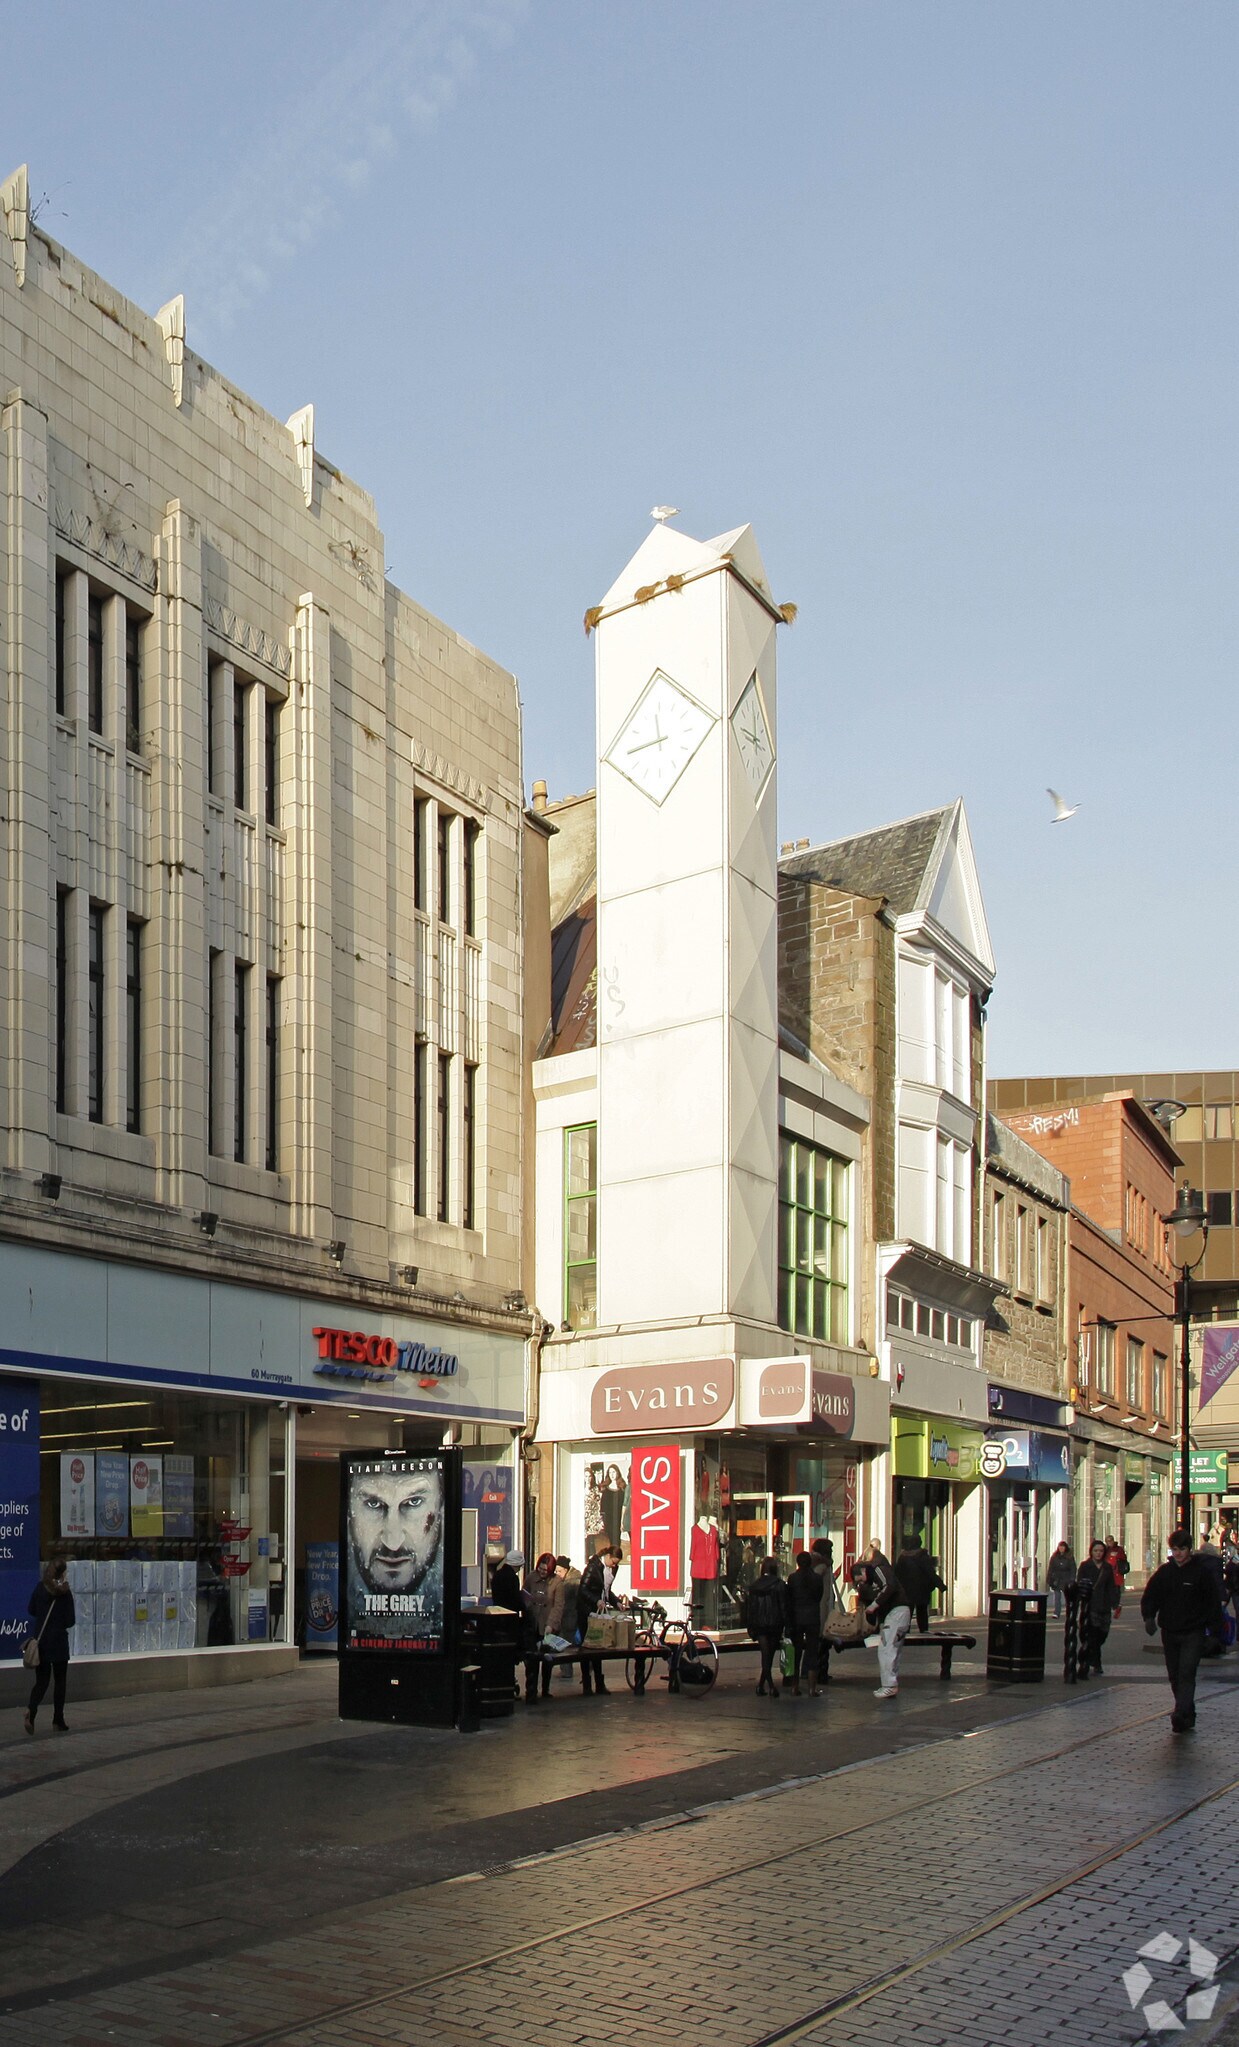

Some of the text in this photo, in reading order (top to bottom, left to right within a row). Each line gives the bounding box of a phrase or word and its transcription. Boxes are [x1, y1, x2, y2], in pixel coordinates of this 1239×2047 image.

[312, 1327, 459, 1376] TESCO Metro
[1205, 1340, 1239, 1377] Wellgat
[604, 1382, 719, 1413] Evans
[761, 1385, 804, 1397] Evans
[11, 1408, 29, 1431] of
[349, 1461, 443, 1474] LIAM NEESON
[1191, 1457, 1209, 1466] LET
[13, 1522, 24, 1537] of
[640, 1456, 671, 1581] SALE
[364, 1594, 425, 1612] THE GREY
[1, 1618, 28, 1640] helps
